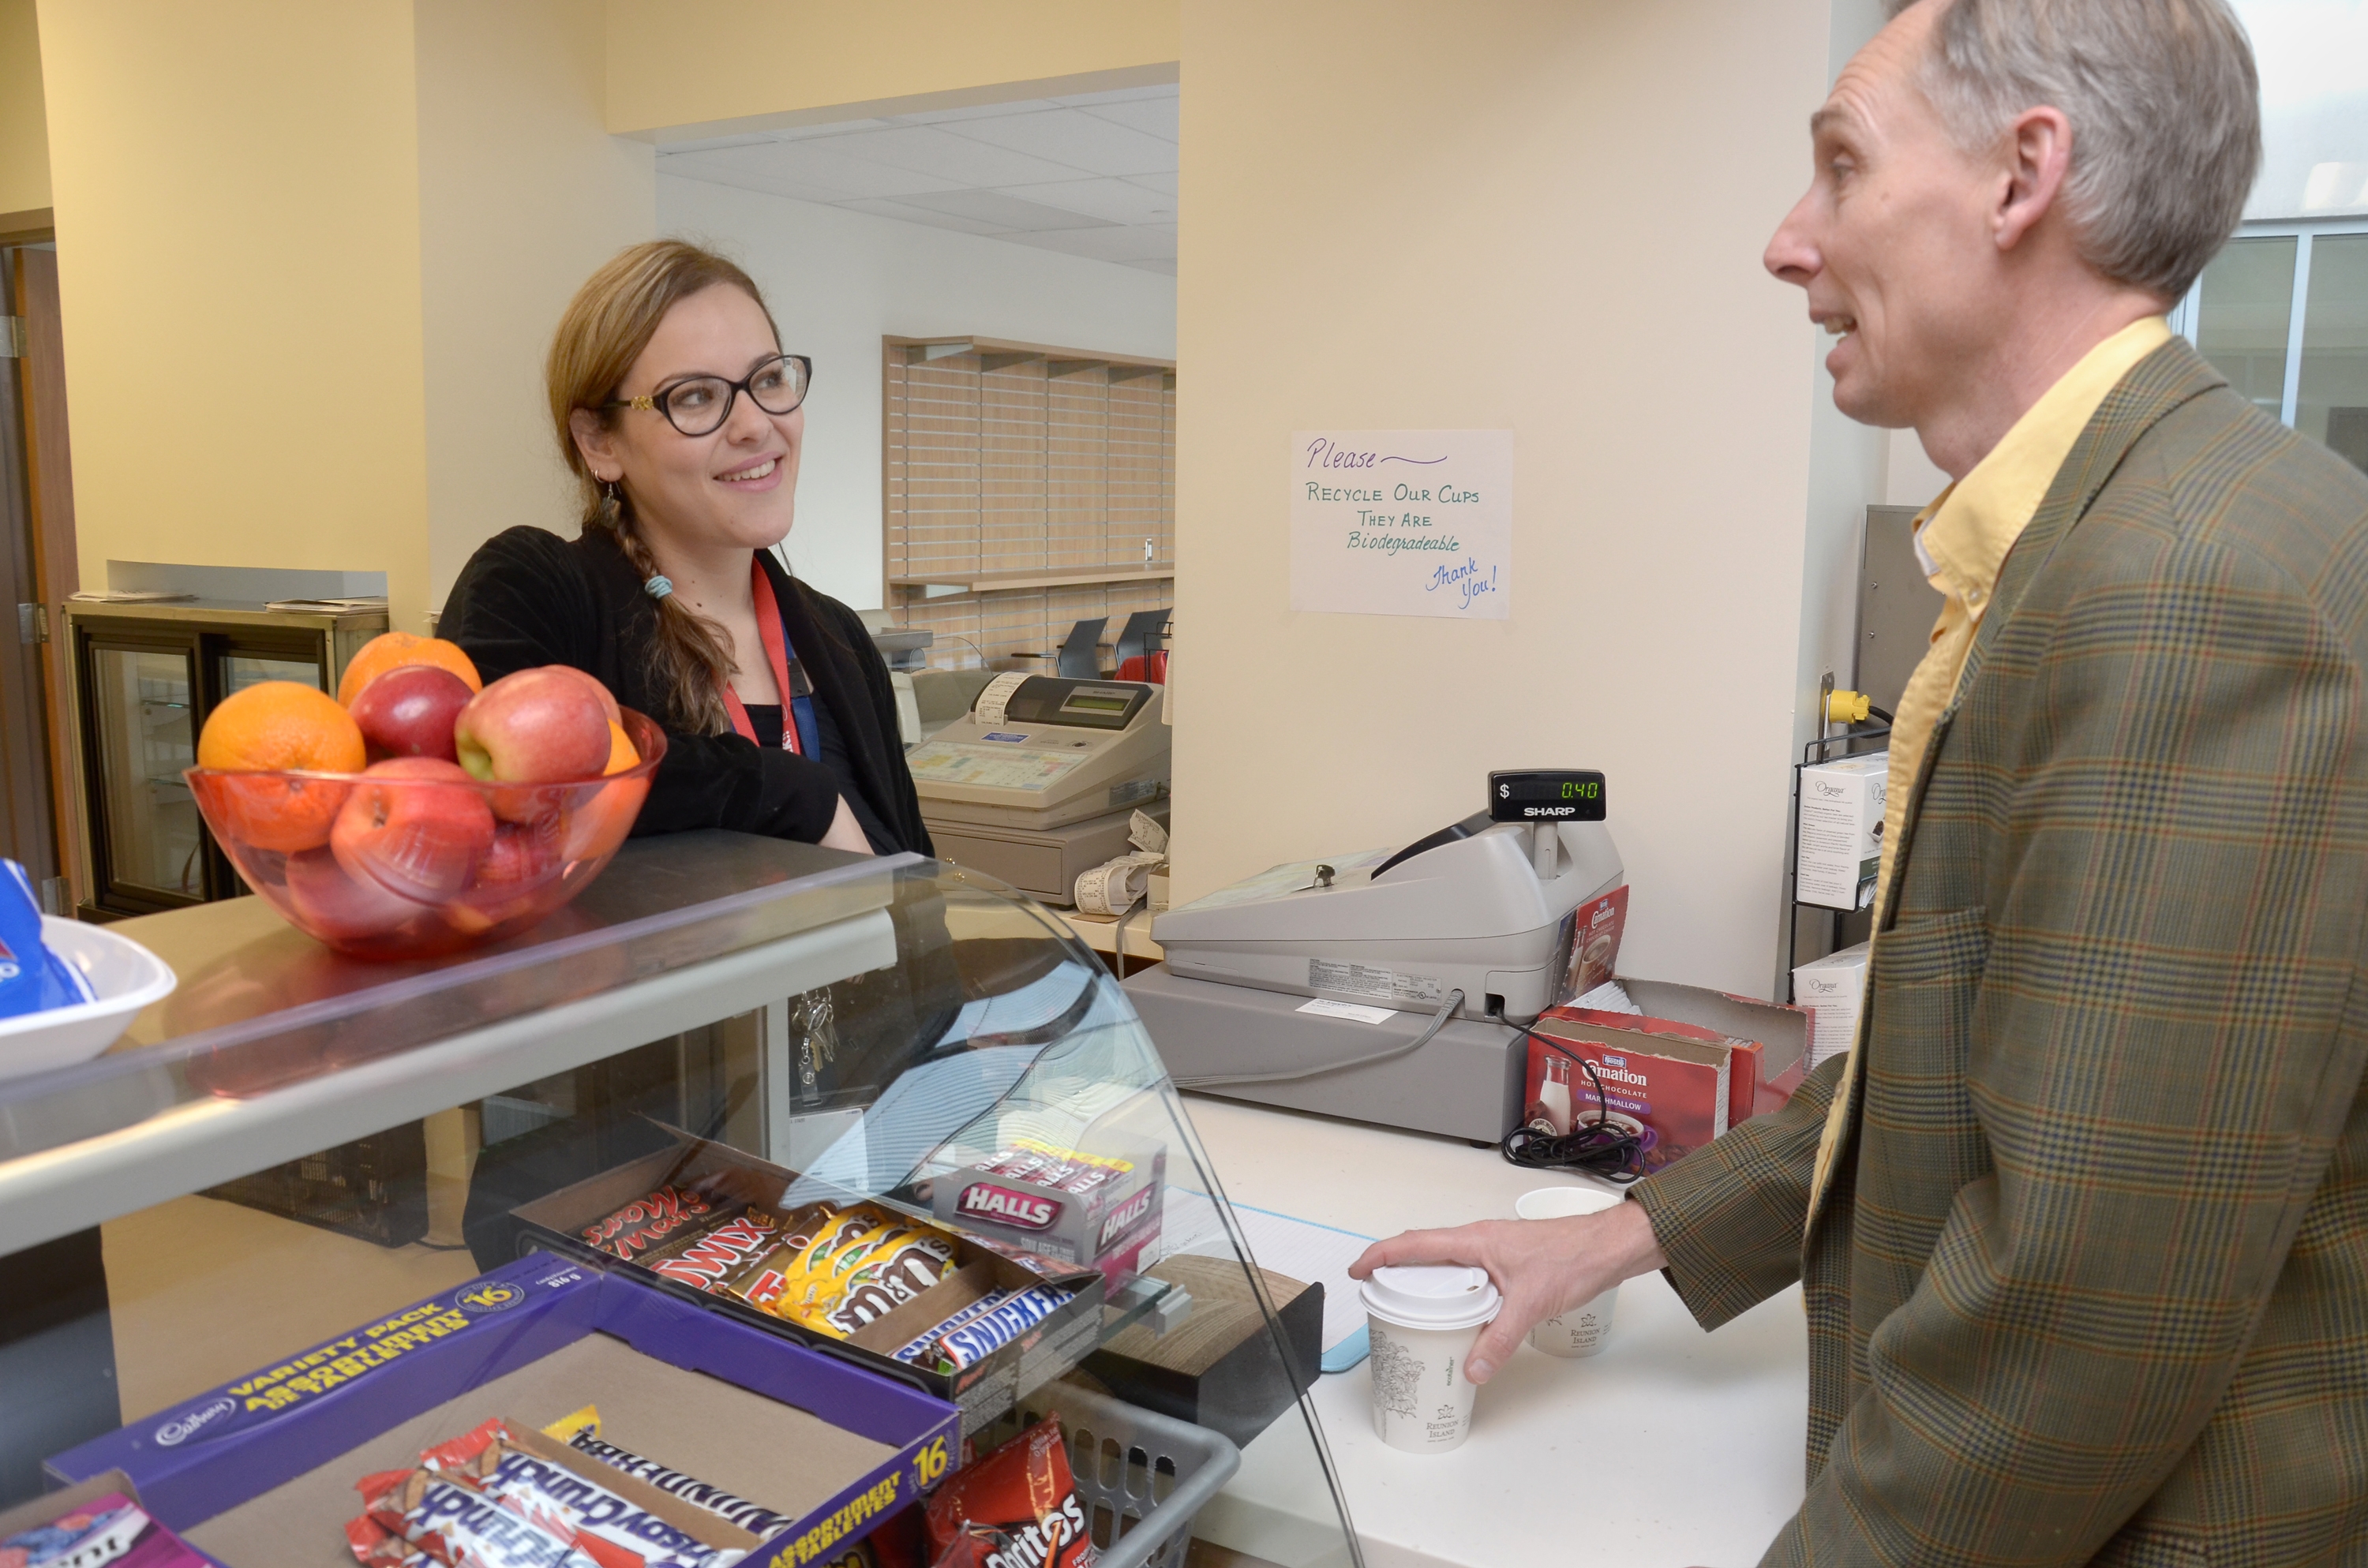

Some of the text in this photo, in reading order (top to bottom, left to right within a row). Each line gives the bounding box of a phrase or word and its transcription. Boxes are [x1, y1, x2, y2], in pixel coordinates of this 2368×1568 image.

[1306, 437, 1376, 468] Please
[1401, 512, 1433, 527] ARE
[1347, 530, 1460, 556] Biodegradeable
[1426, 556, 1478, 591] Thank
[1500, 782, 1598, 799] $ 0.40
[1815, 780, 1845, 798] Organa
[1523, 807, 1576, 817] SHARP
[1591, 907, 1615, 930] Carnation
[1809, 979, 1838, 994] Organa
[1582, 1059, 1647, 1087] Carnation
[1581, 1080, 1647, 1099] HOT CHOCOLATE
[1585, 1093, 1642, 1111] MARHMALLOW
[975, 1150, 1014, 1171] ALLS
[1006, 1157, 1044, 1180] ALLS
[1036, 1164, 1075, 1187] ALLS
[1067, 1172, 1106, 1195] ALLS
[582, 1184, 679, 1247] Mars
[965, 1186, 1054, 1225] HALLS
[1100, 1188, 1152, 1248] HALLS
[615, 1203, 710, 1261] Mars
[463, 1285, 513, 1307] 16
[1571, 1327, 1601, 1336] REUNION
[228, 1302, 444, 1396] VARIETY PACK
[155, 1397, 236, 1446] Cadbury
[1426, 1419, 1459, 1430] REUNION
[1429, 1429, 1455, 1438] ISLAND
[913, 1435, 948, 1487] 16
[612, 1510, 720, 1562] rispy
[987, 1493, 1085, 1568] Doritos
